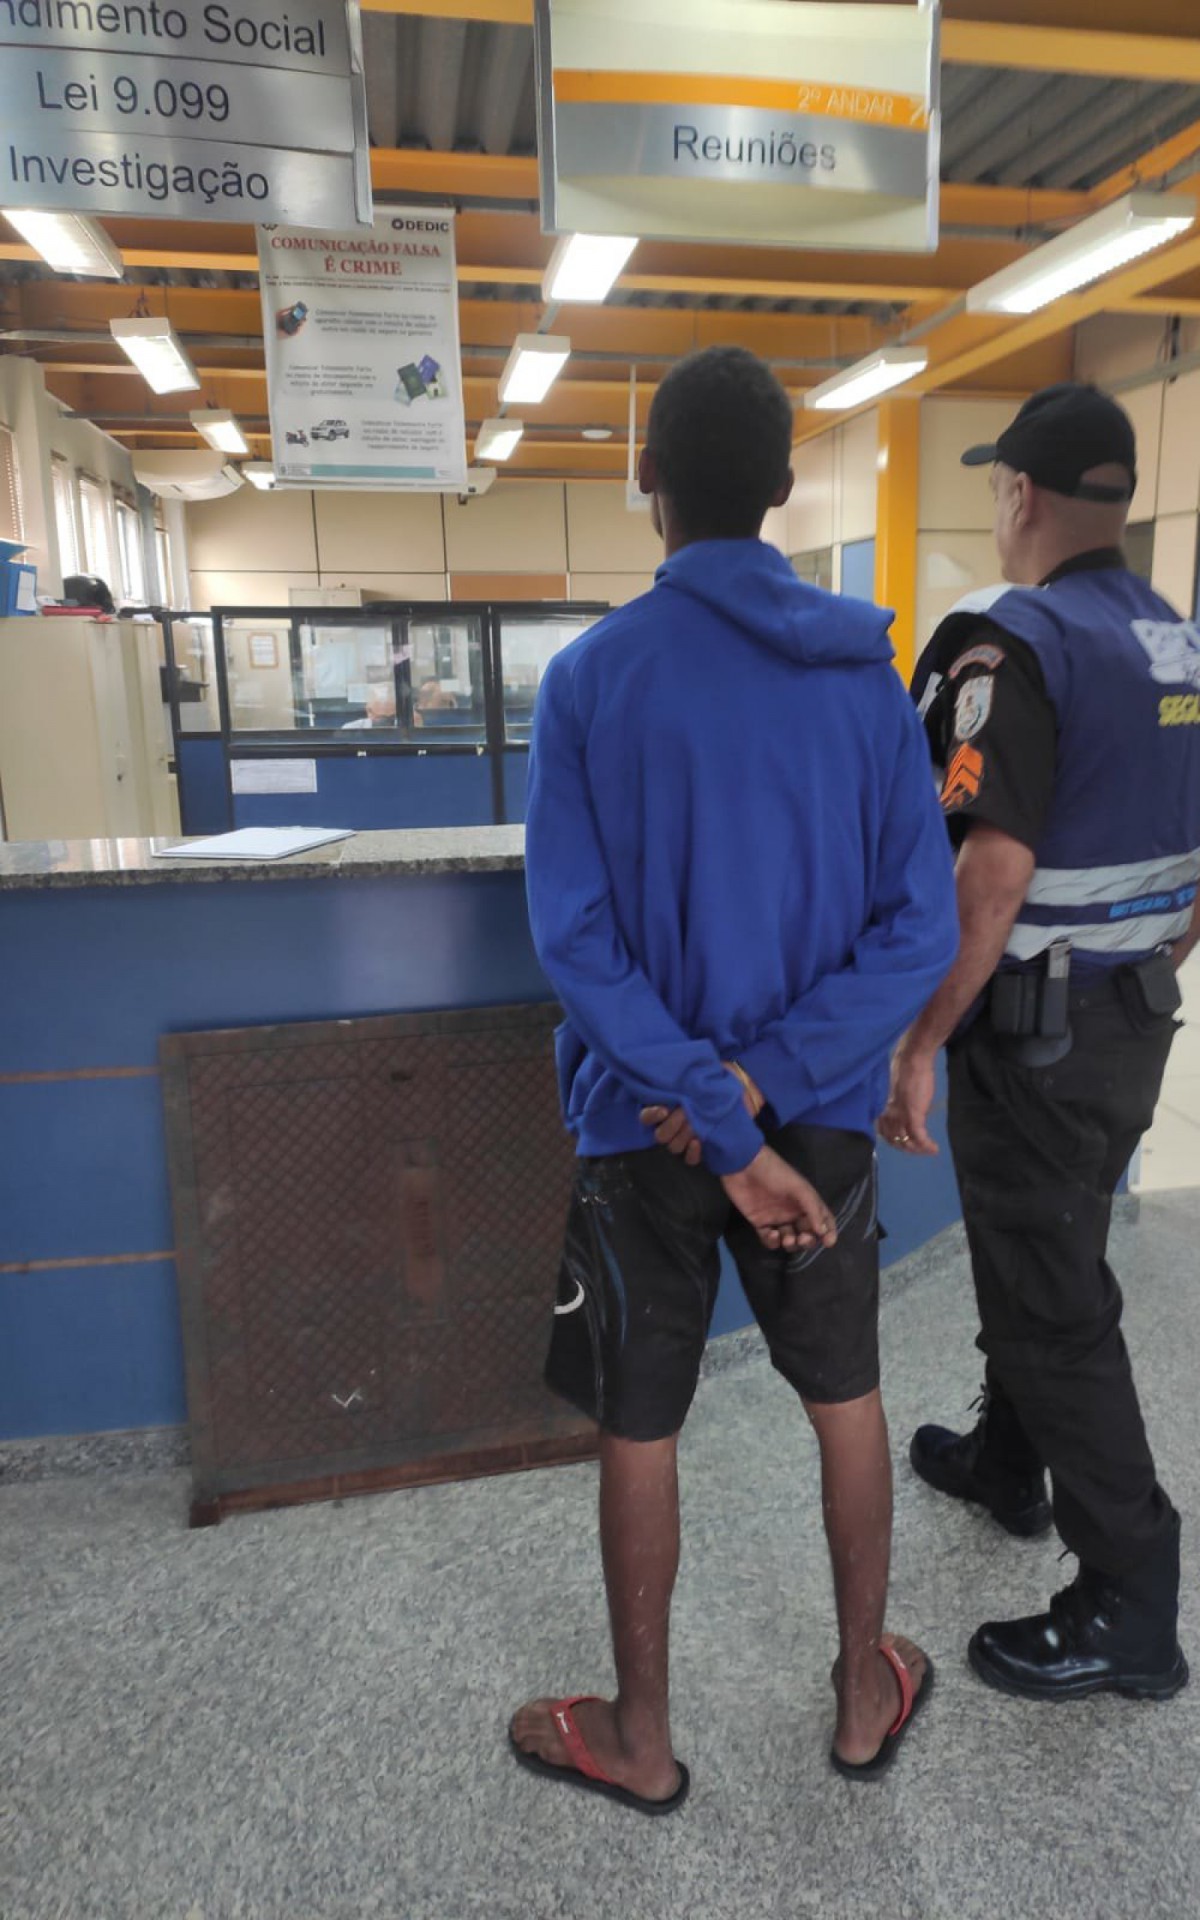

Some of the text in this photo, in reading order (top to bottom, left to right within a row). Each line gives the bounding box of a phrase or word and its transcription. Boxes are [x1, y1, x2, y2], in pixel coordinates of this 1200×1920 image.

[203, 5, 325, 57] Social
[37, 71, 230, 121] Lei 9.099
[826, 89, 894, 121] ANDAR
[673, 125, 836, 171] Reuniões
[10, 145, 270, 204] Investigação
[271, 236, 441, 258] COMUNICAÇÃO FALSA
[324, 255, 402, 276] É CRIME
